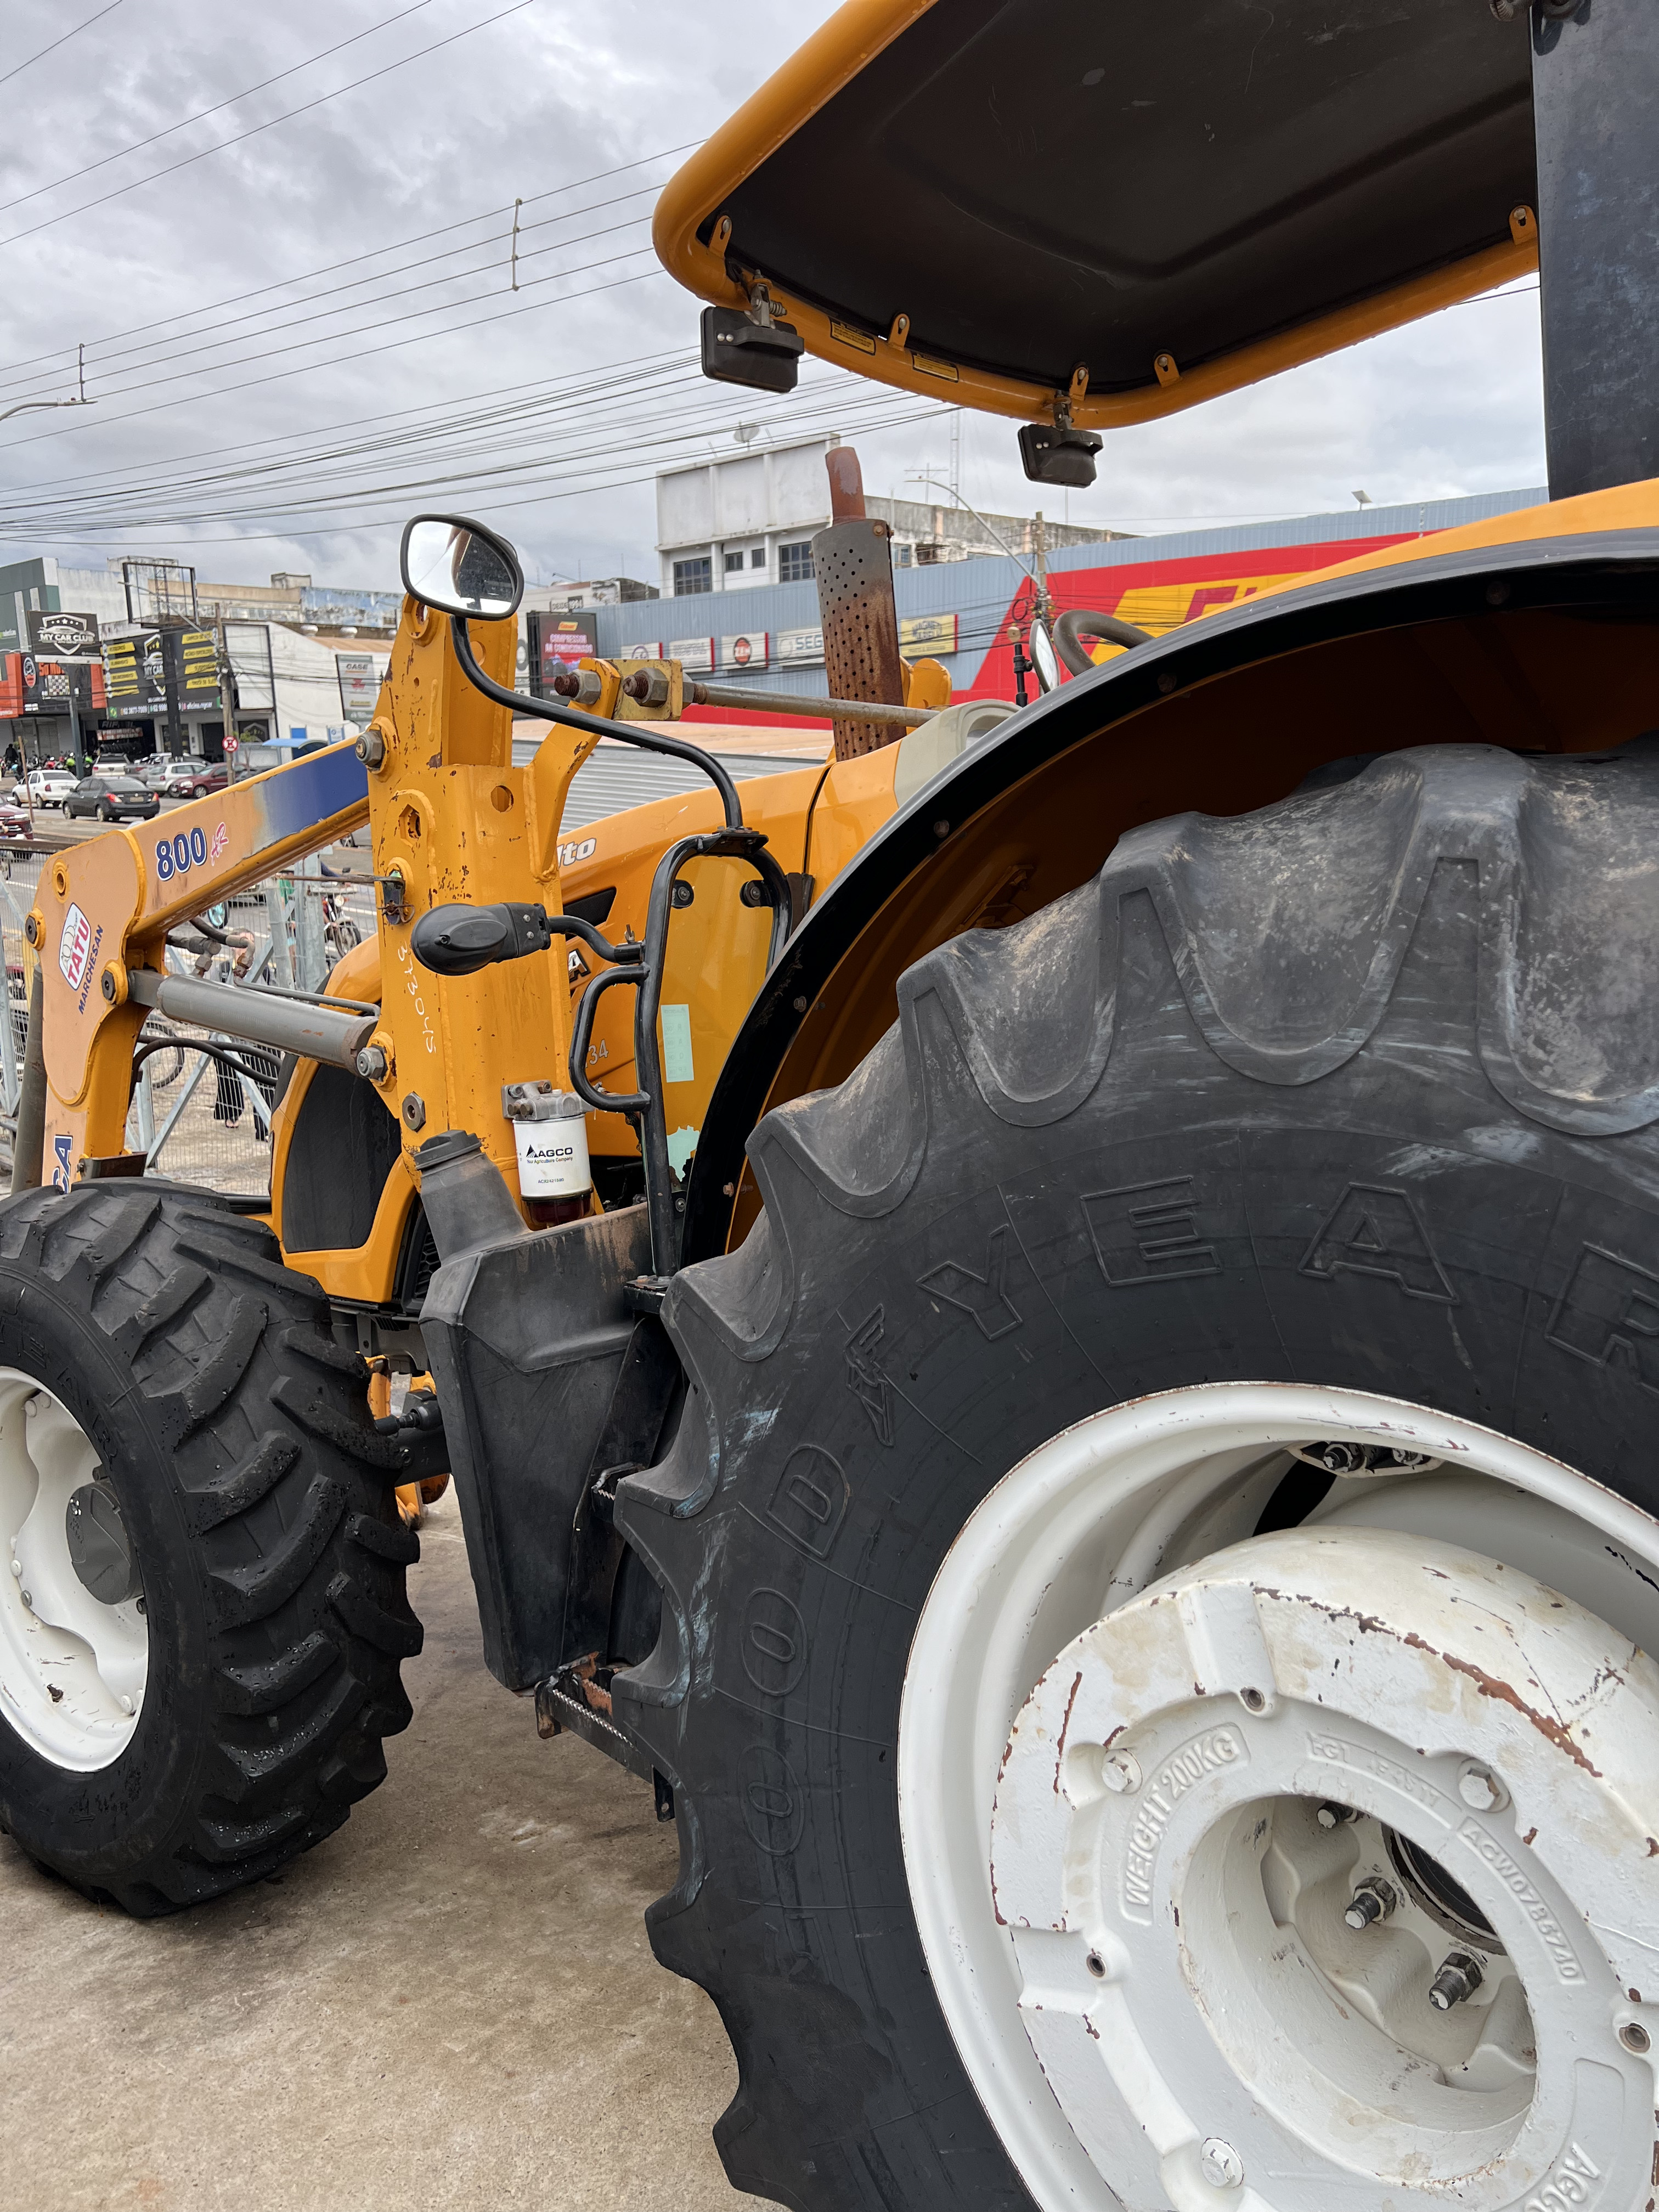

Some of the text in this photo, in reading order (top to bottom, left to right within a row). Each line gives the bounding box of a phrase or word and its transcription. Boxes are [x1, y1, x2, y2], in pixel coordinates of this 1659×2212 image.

[40, 633, 53, 641] MY
[54, 634, 72, 642] CAR
[550, 634, 587, 643] COMPRESSOR
[156, 827, 207, 881] 800
[67, 918, 89, 986] TATU
[78, 924, 104, 1015] MARCHESAN
[585, 1039, 609, 1068] 34
[538, 1147, 573, 1158] AGCO
[1126, 1730, 1241, 1907] WEIGHT 200KG
